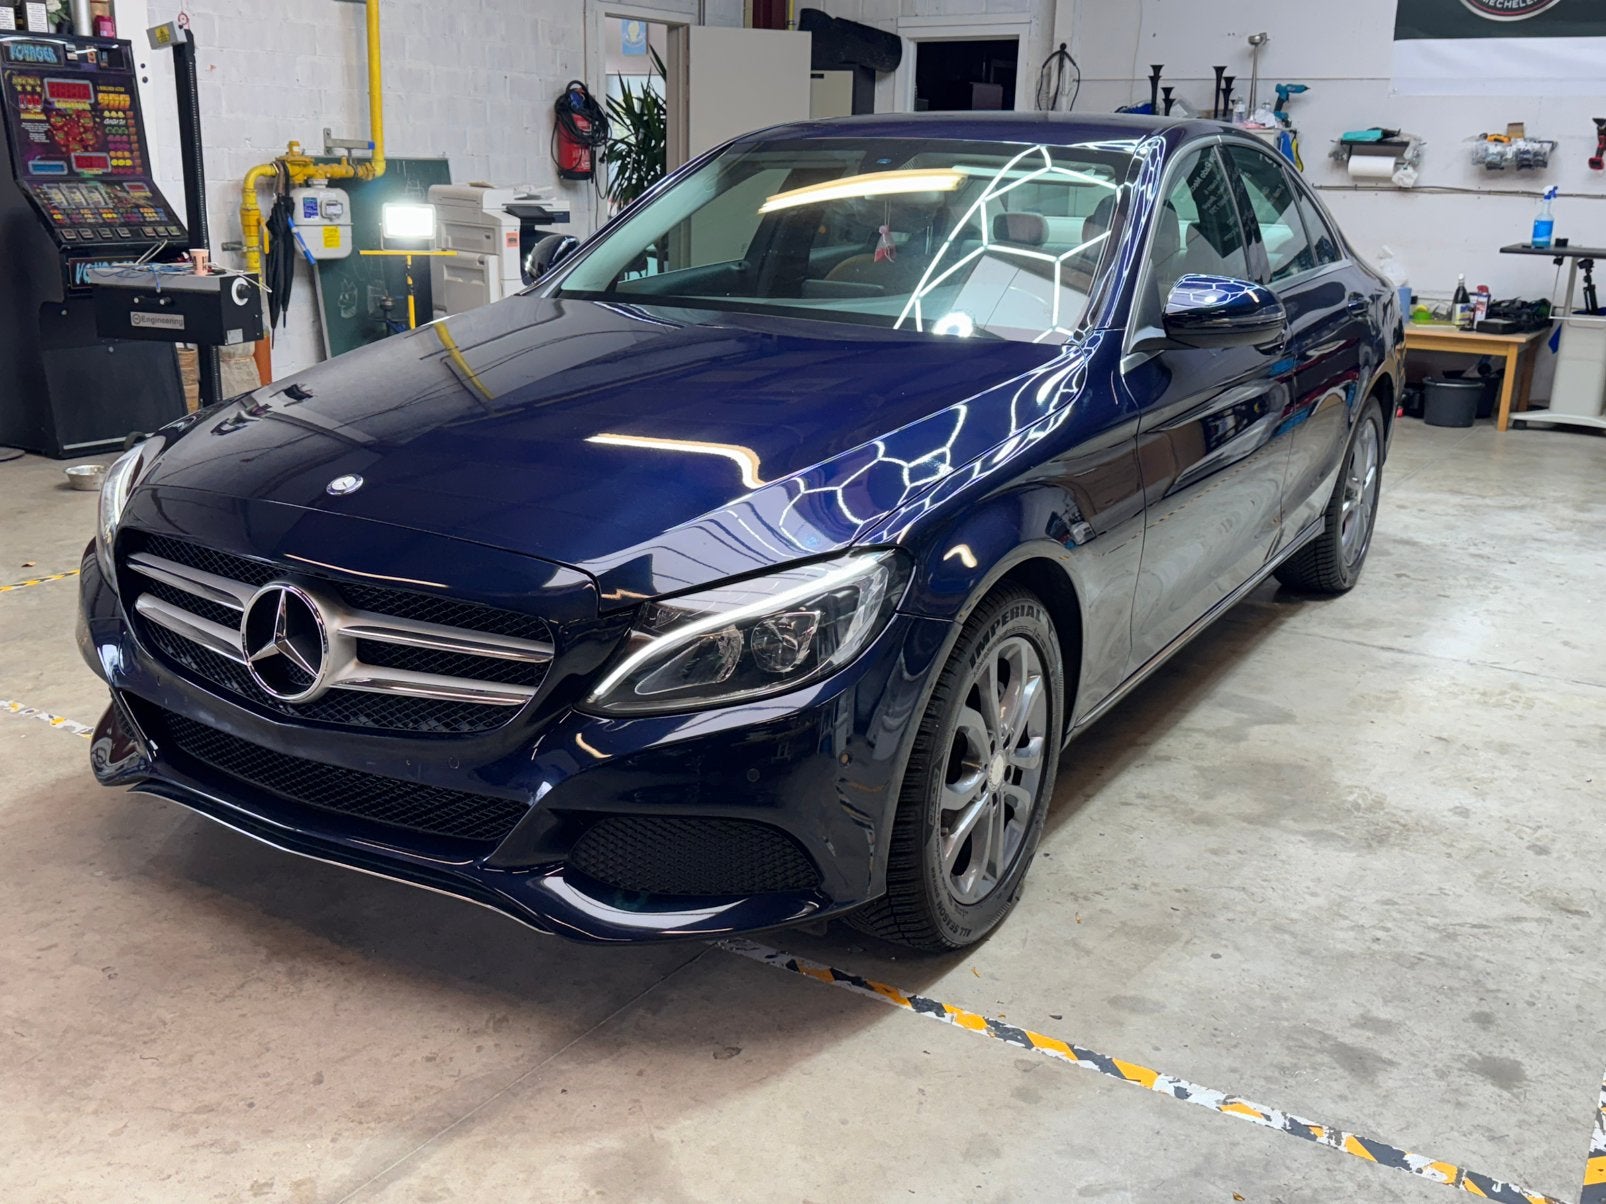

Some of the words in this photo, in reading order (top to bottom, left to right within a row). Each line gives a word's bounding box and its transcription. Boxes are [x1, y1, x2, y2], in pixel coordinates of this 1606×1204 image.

[1481, 0, 1537, 9] ECHELE
[969, 604, 1041, 669] IMPERIAL
[936, 900, 960, 934] SEASON
[960, 926, 973, 938] ALL
